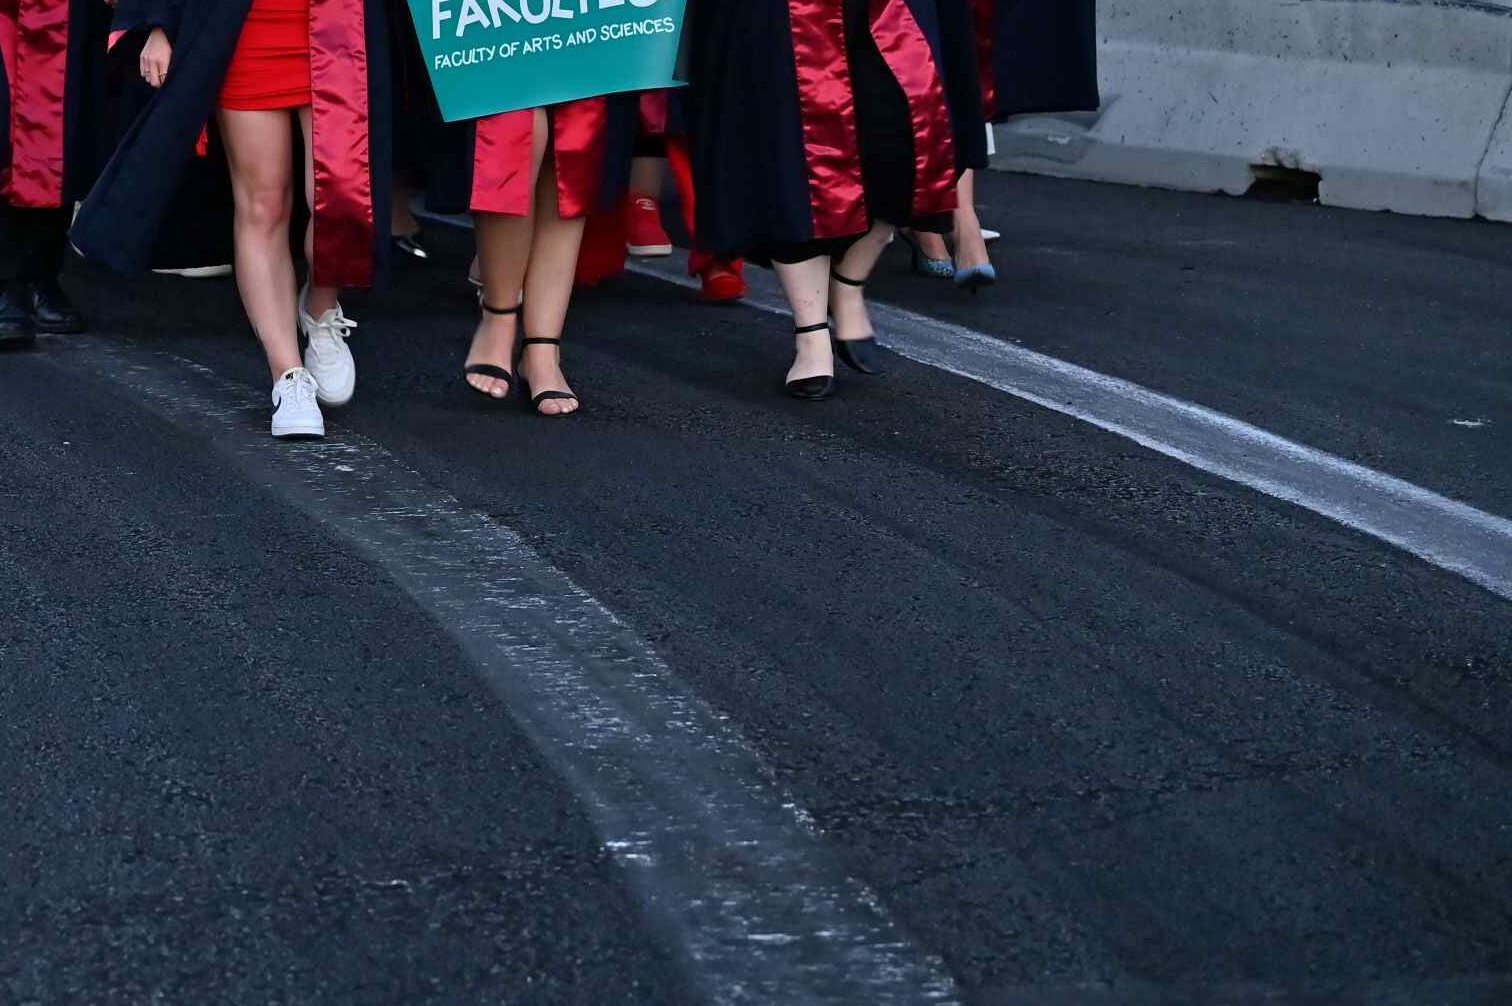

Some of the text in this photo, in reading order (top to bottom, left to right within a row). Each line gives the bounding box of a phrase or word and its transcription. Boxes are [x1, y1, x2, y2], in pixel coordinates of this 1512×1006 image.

[434, 17, 675, 70] FACULTY OF ARTS AND SCIENCES
